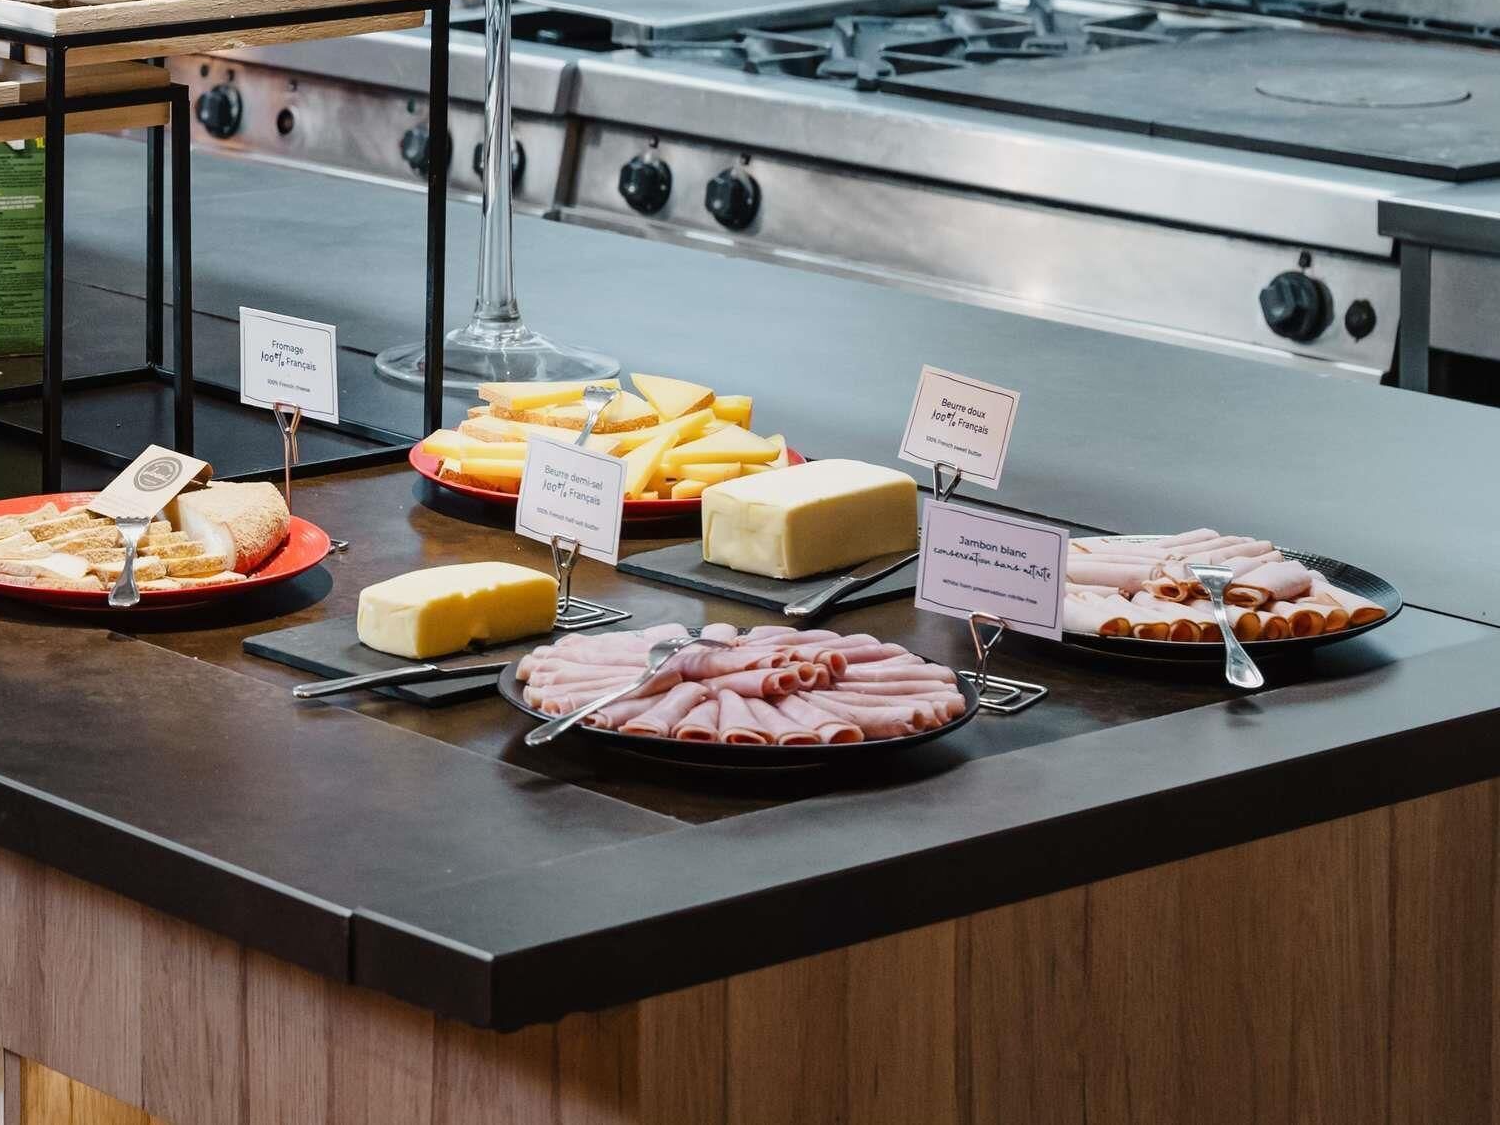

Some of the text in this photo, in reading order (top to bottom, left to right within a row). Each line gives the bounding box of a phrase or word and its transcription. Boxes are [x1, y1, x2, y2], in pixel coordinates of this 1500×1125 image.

[271, 340, 304, 355] Fromage
[260, 351, 316, 372] 100% Français
[941, 398, 987, 419] Beurre doux
[931, 409, 989, 435] 100% Français
[544, 464, 603, 491] Beurre demi-sel
[541, 479, 601, 506] 100% Français
[959, 535, 1028, 559] Jambon blanc
[933, 547, 1052, 583] conservation sans nitrite
